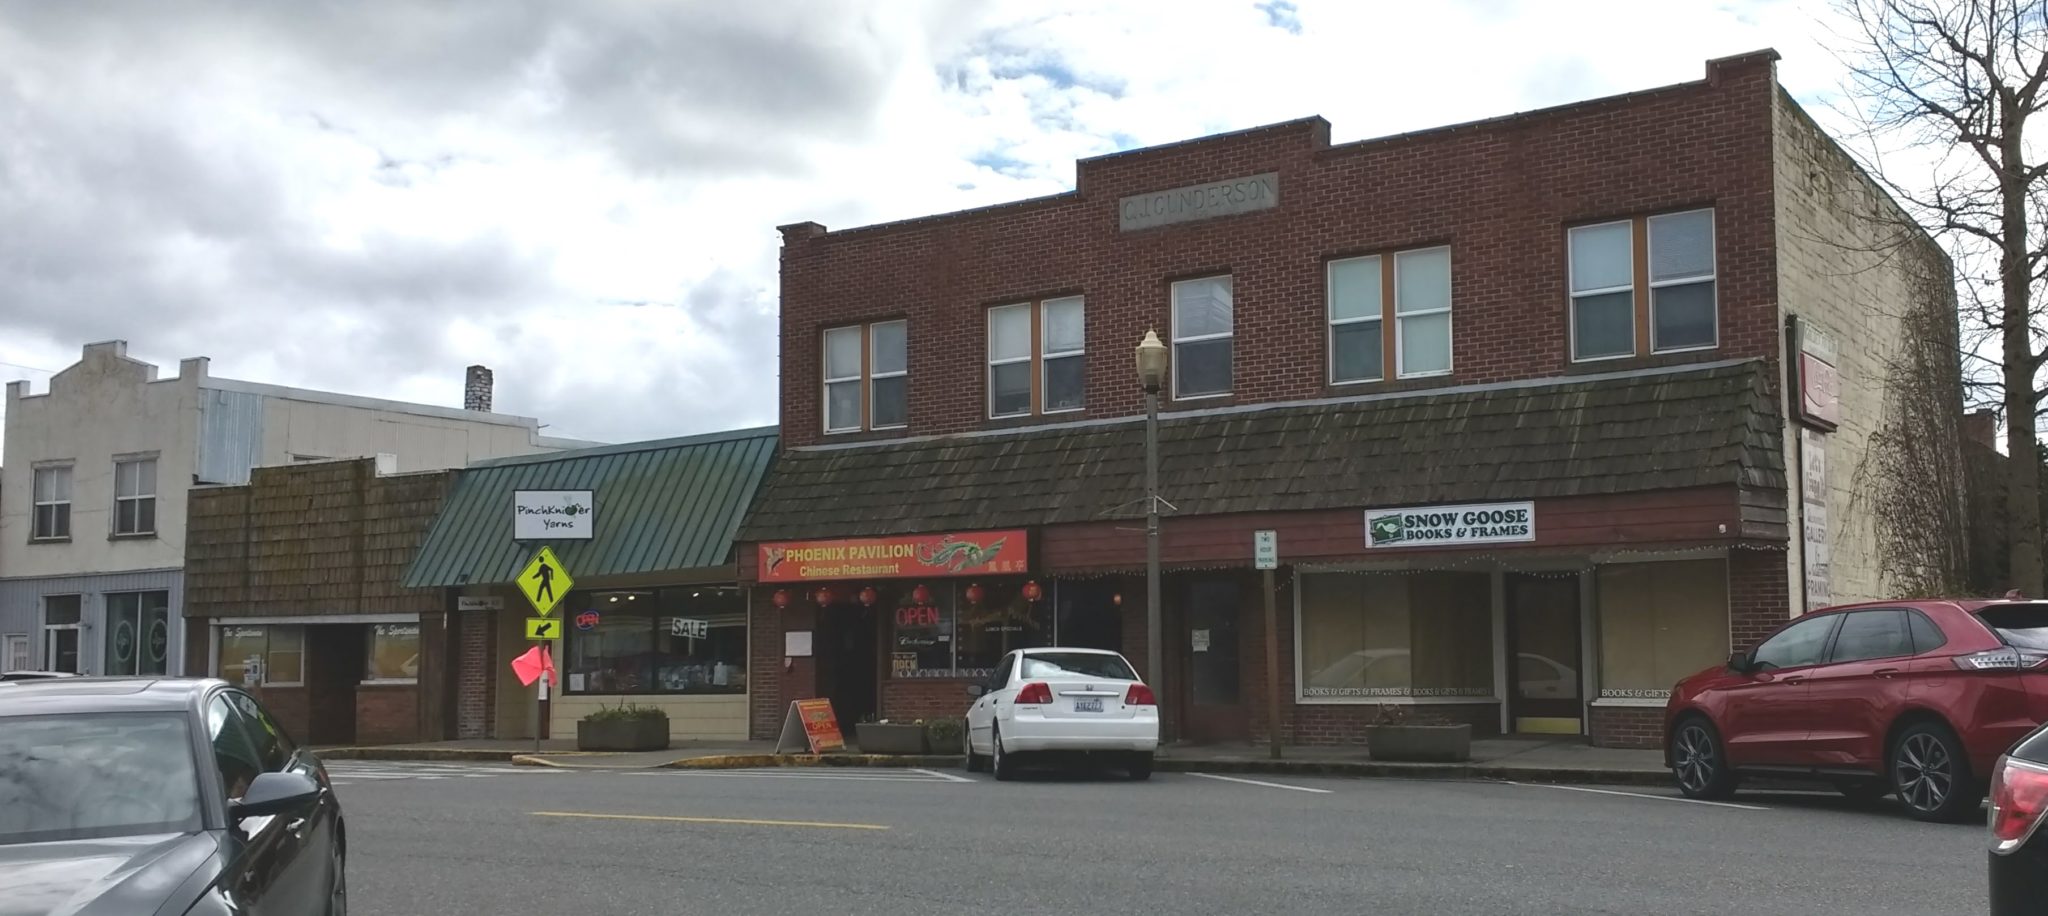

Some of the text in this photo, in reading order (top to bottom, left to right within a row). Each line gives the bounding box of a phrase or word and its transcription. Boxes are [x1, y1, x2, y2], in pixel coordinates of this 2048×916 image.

[517, 503, 591, 515] PinchKnier
[543, 519, 574, 530] Yarns
[1404, 509, 1528, 529] SNOW GOOSE
[1406, 525, 1528, 540] BOOKS & FRAMES
[786, 543, 914, 562] PHOENIX PAVILION
[800, 563, 899, 577] Chinese Restaurant
[896, 606, 940, 625] OPEN
[672, 619, 707, 639] SALE
[1303, 687, 1330, 696] BOOKS
[1338, 687, 1360, 696] GIFTS
[1370, 687, 1402, 696] FRAMES
[1601, 689, 1672, 698] BOOKS & GIFTS
